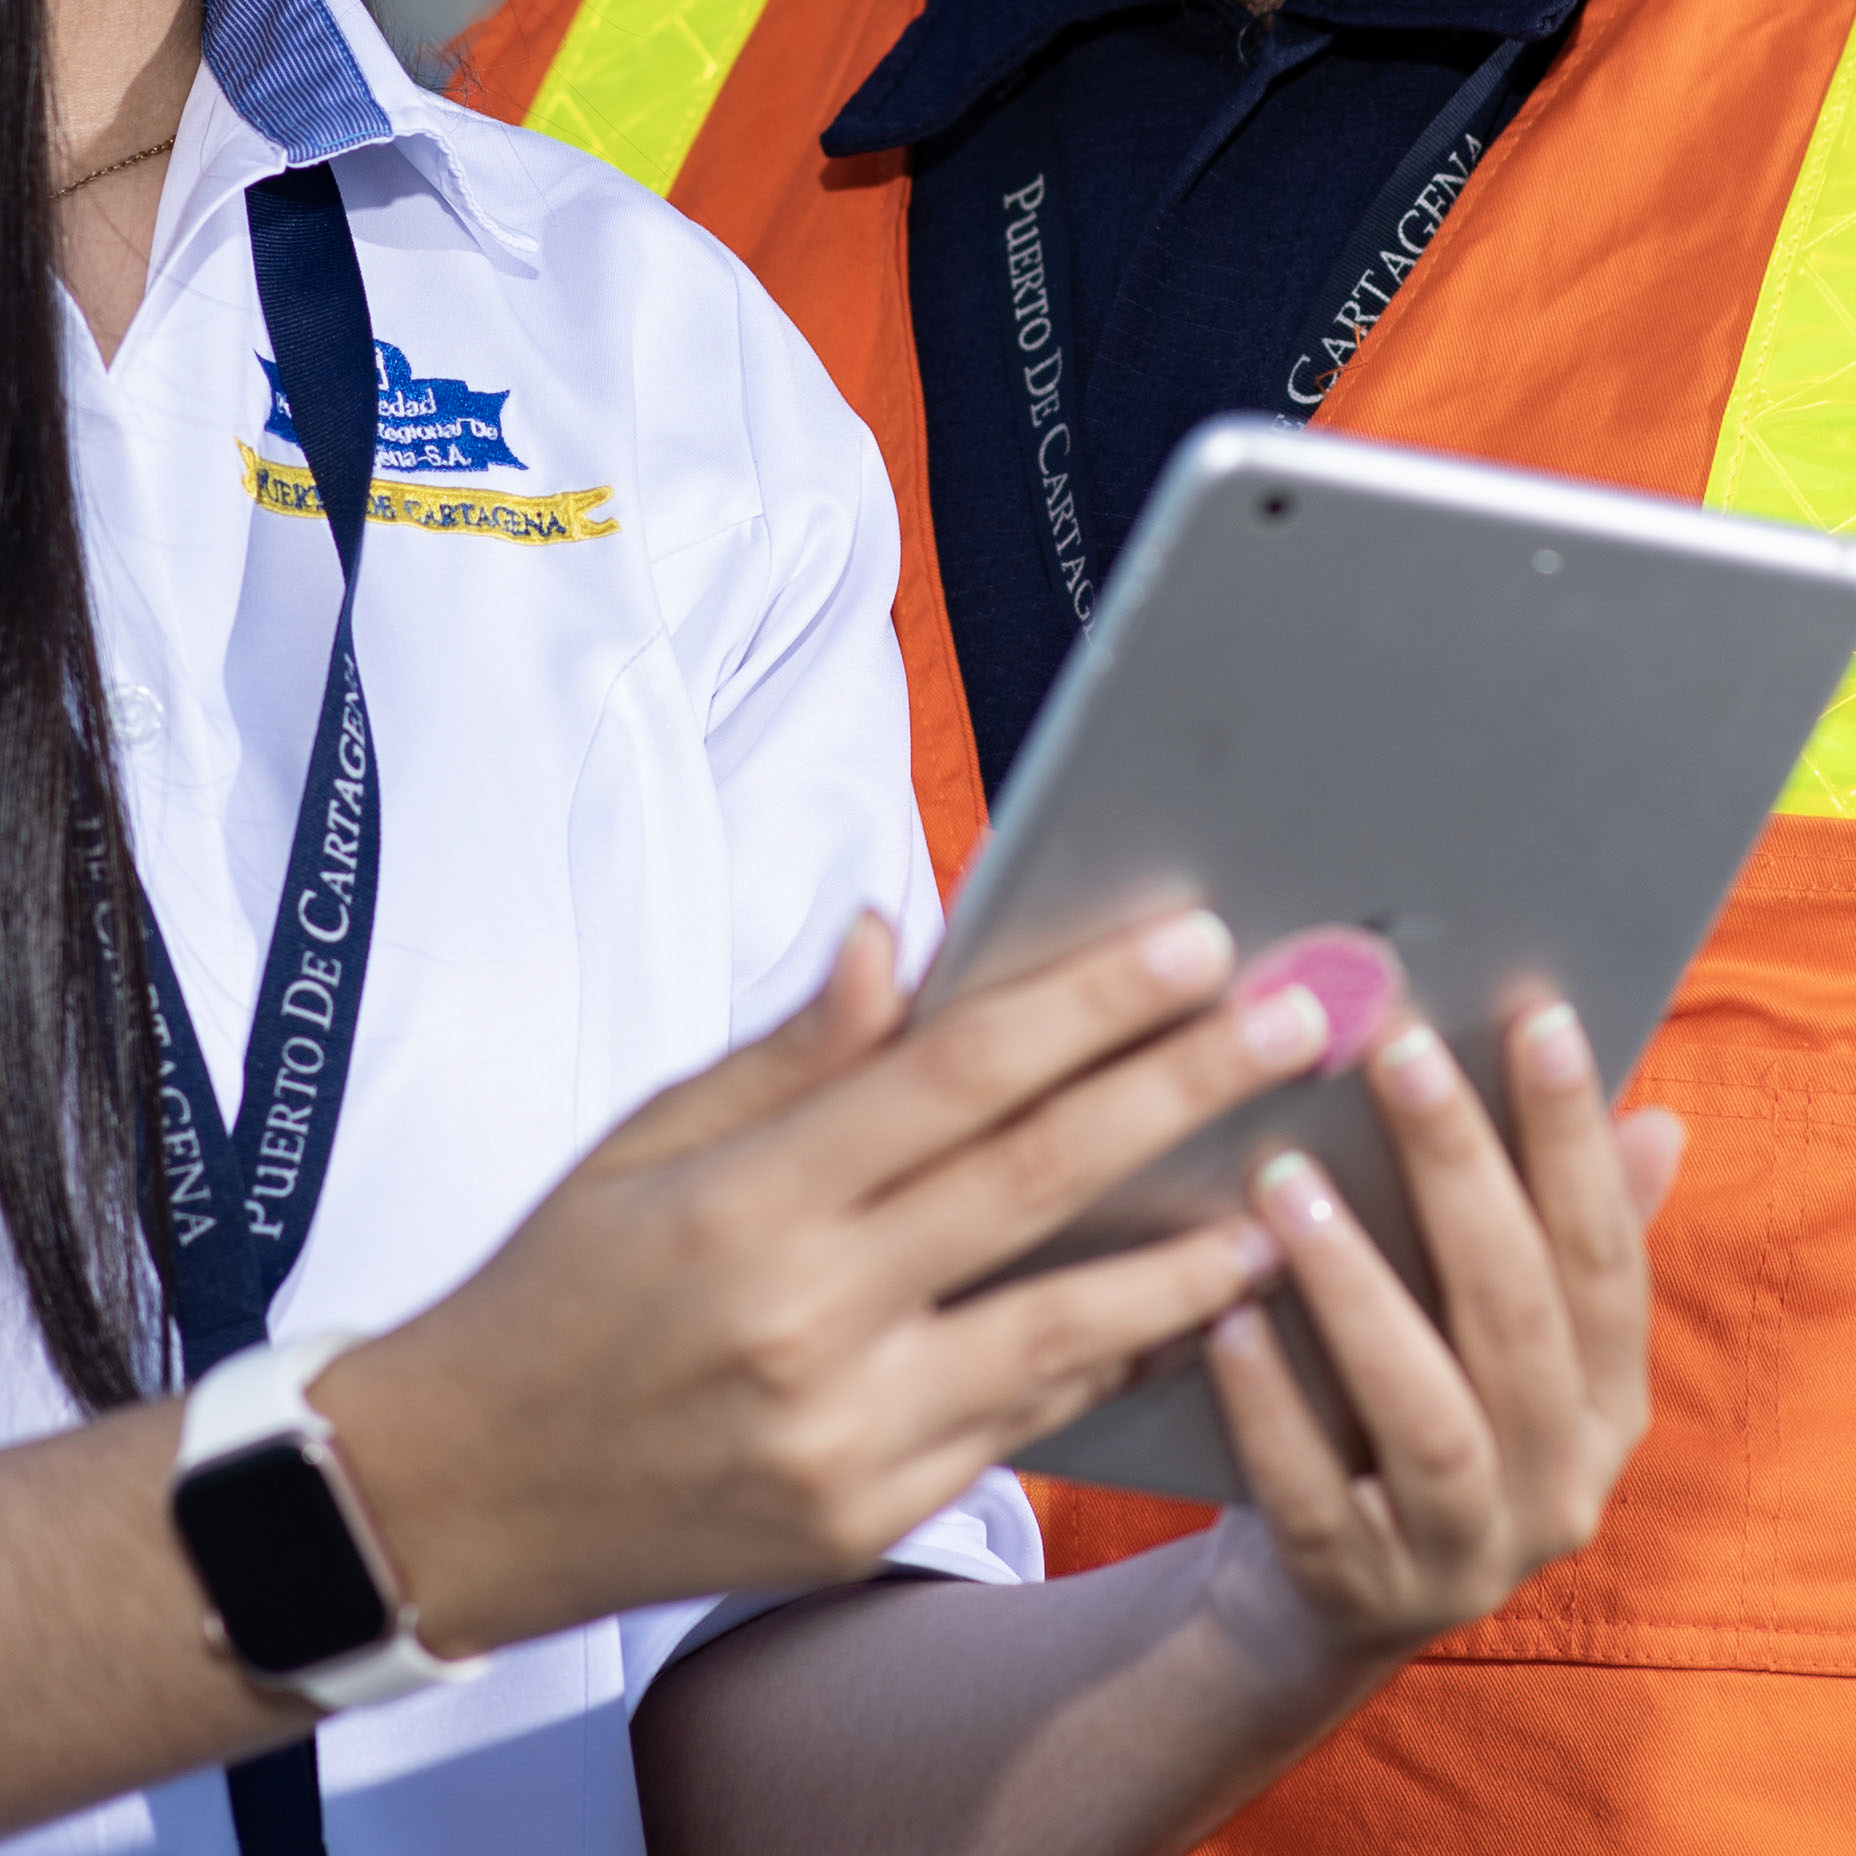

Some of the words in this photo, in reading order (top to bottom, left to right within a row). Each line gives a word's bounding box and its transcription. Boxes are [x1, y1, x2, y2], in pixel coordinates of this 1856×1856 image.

[1003, 173, 1052, 351] PUERTO
[378, 387, 438, 418] edad
[1024, 346, 1063, 428] DE
[257, 468, 326, 510] PUERT
[1038, 422, 1096, 644] CARTAG
[281, 950, 343, 1033] DE
[244, 1036, 326, 1241] PUERTO
